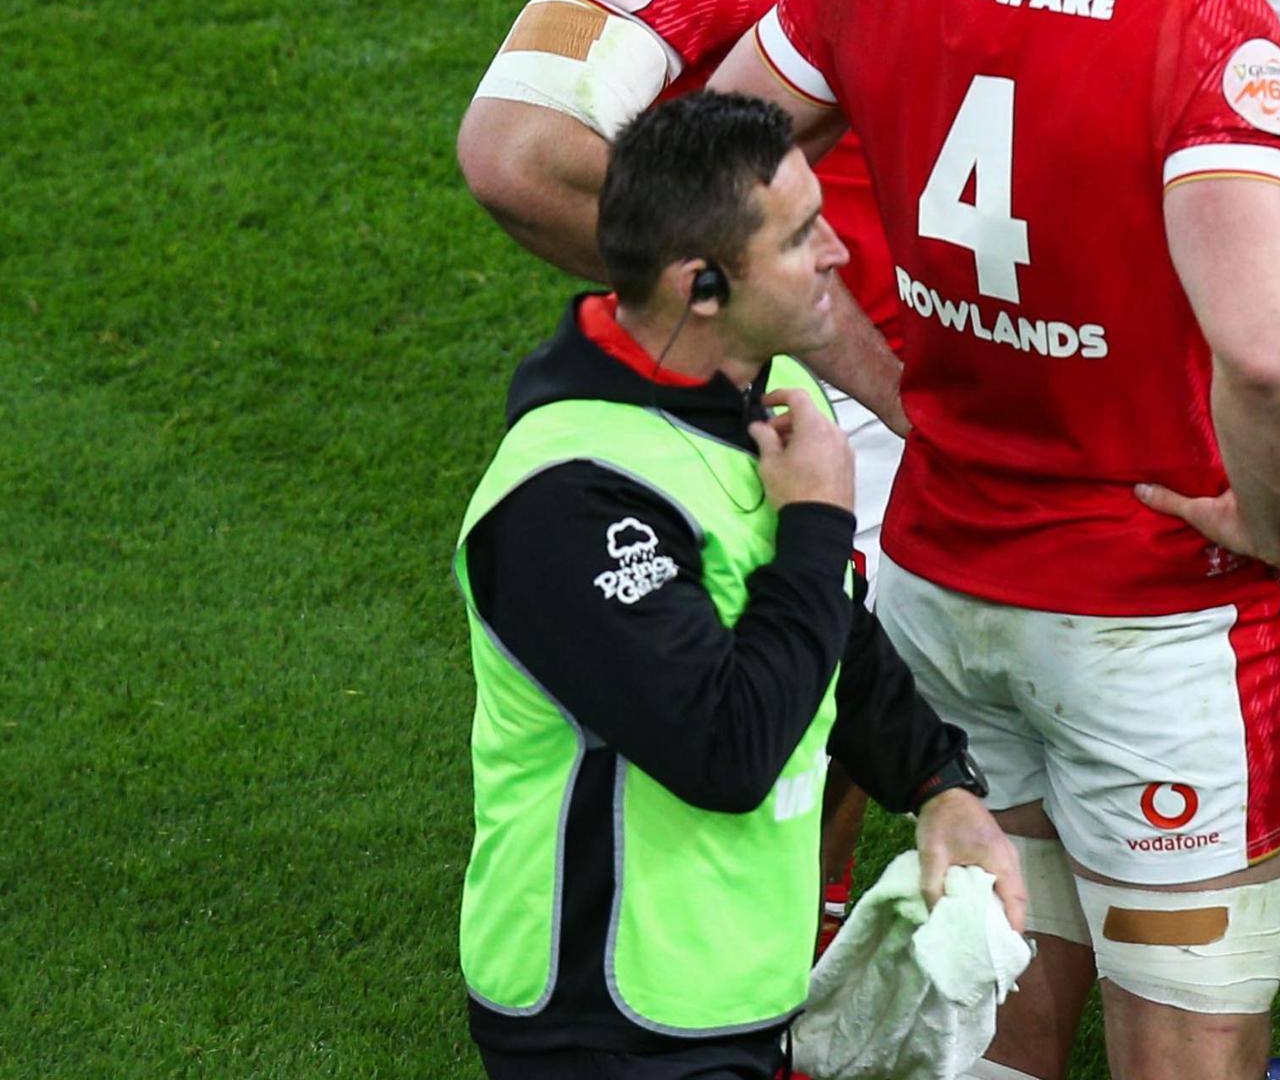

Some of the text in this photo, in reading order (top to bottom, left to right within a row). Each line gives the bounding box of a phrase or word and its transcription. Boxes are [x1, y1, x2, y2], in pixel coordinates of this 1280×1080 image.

[918, 74, 1030, 304] 4
[895, 265, 1108, 359] ROWLANDS
[1127, 831, 1219, 851] vodafone
